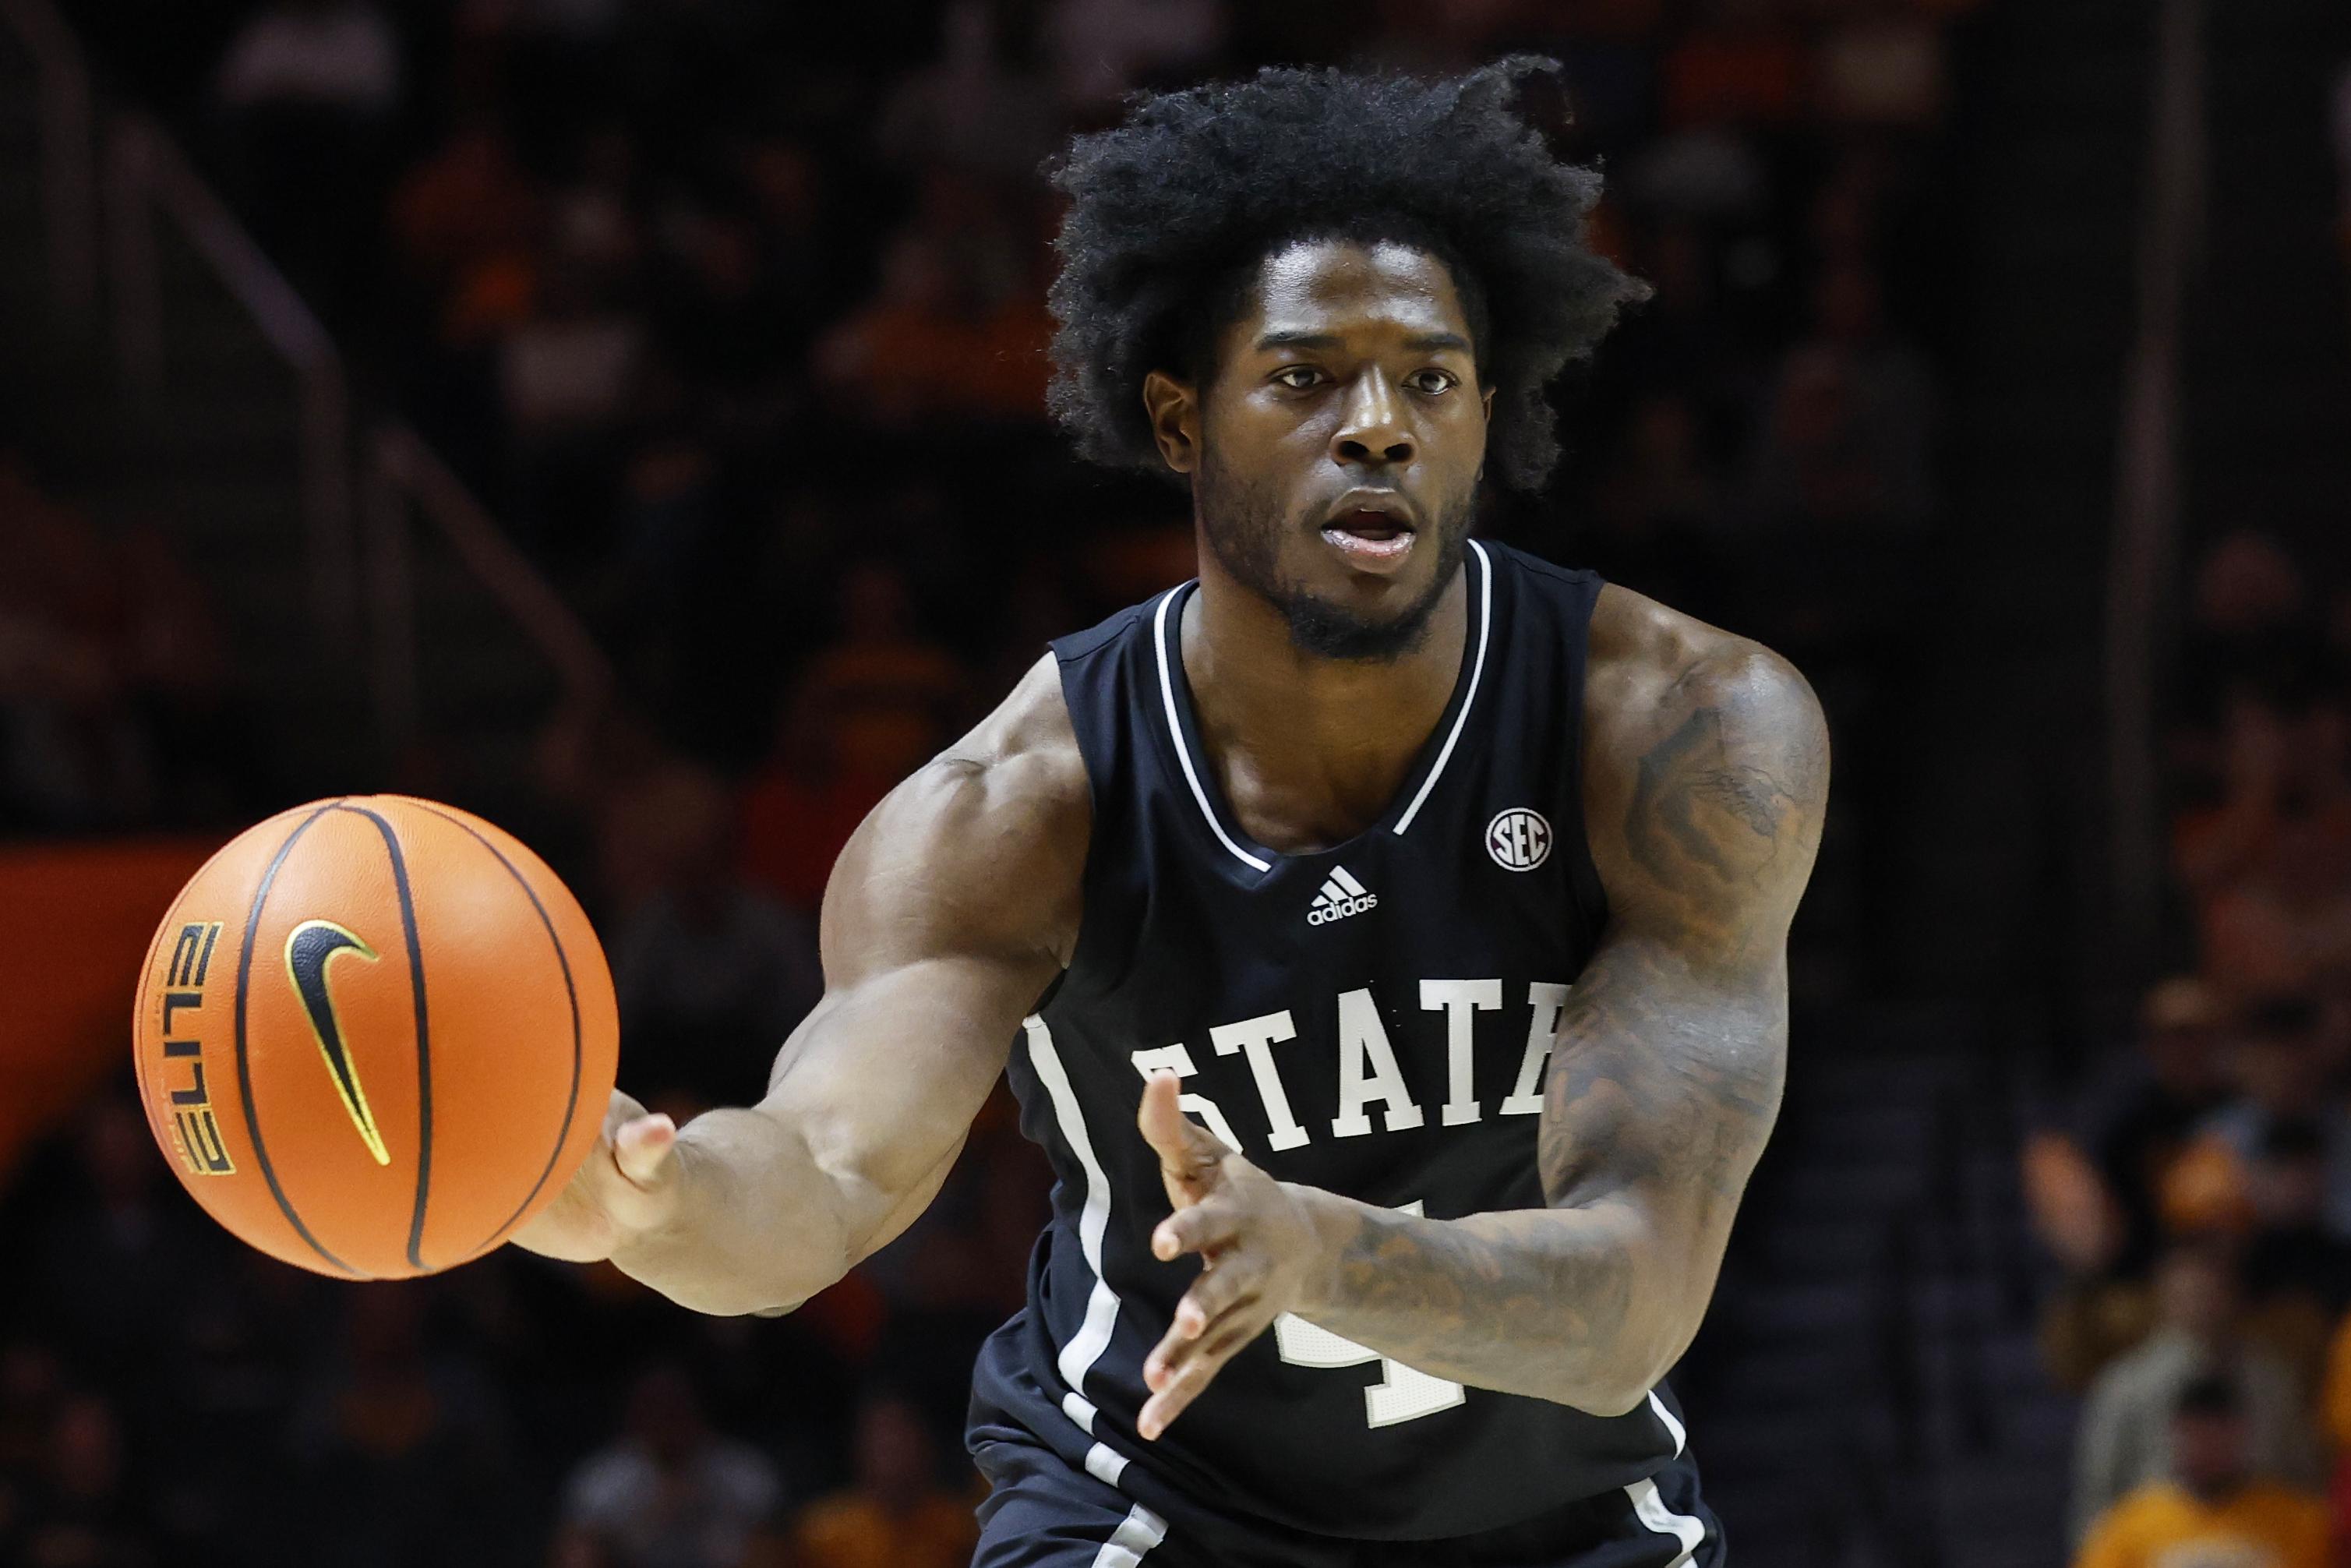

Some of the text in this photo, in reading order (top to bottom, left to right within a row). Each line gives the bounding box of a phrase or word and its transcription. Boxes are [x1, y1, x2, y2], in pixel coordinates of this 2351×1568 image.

[1492, 814, 1546, 867] SEC
[1306, 893, 1378, 927] adidas
[162, 921, 237, 1176] ELITE
